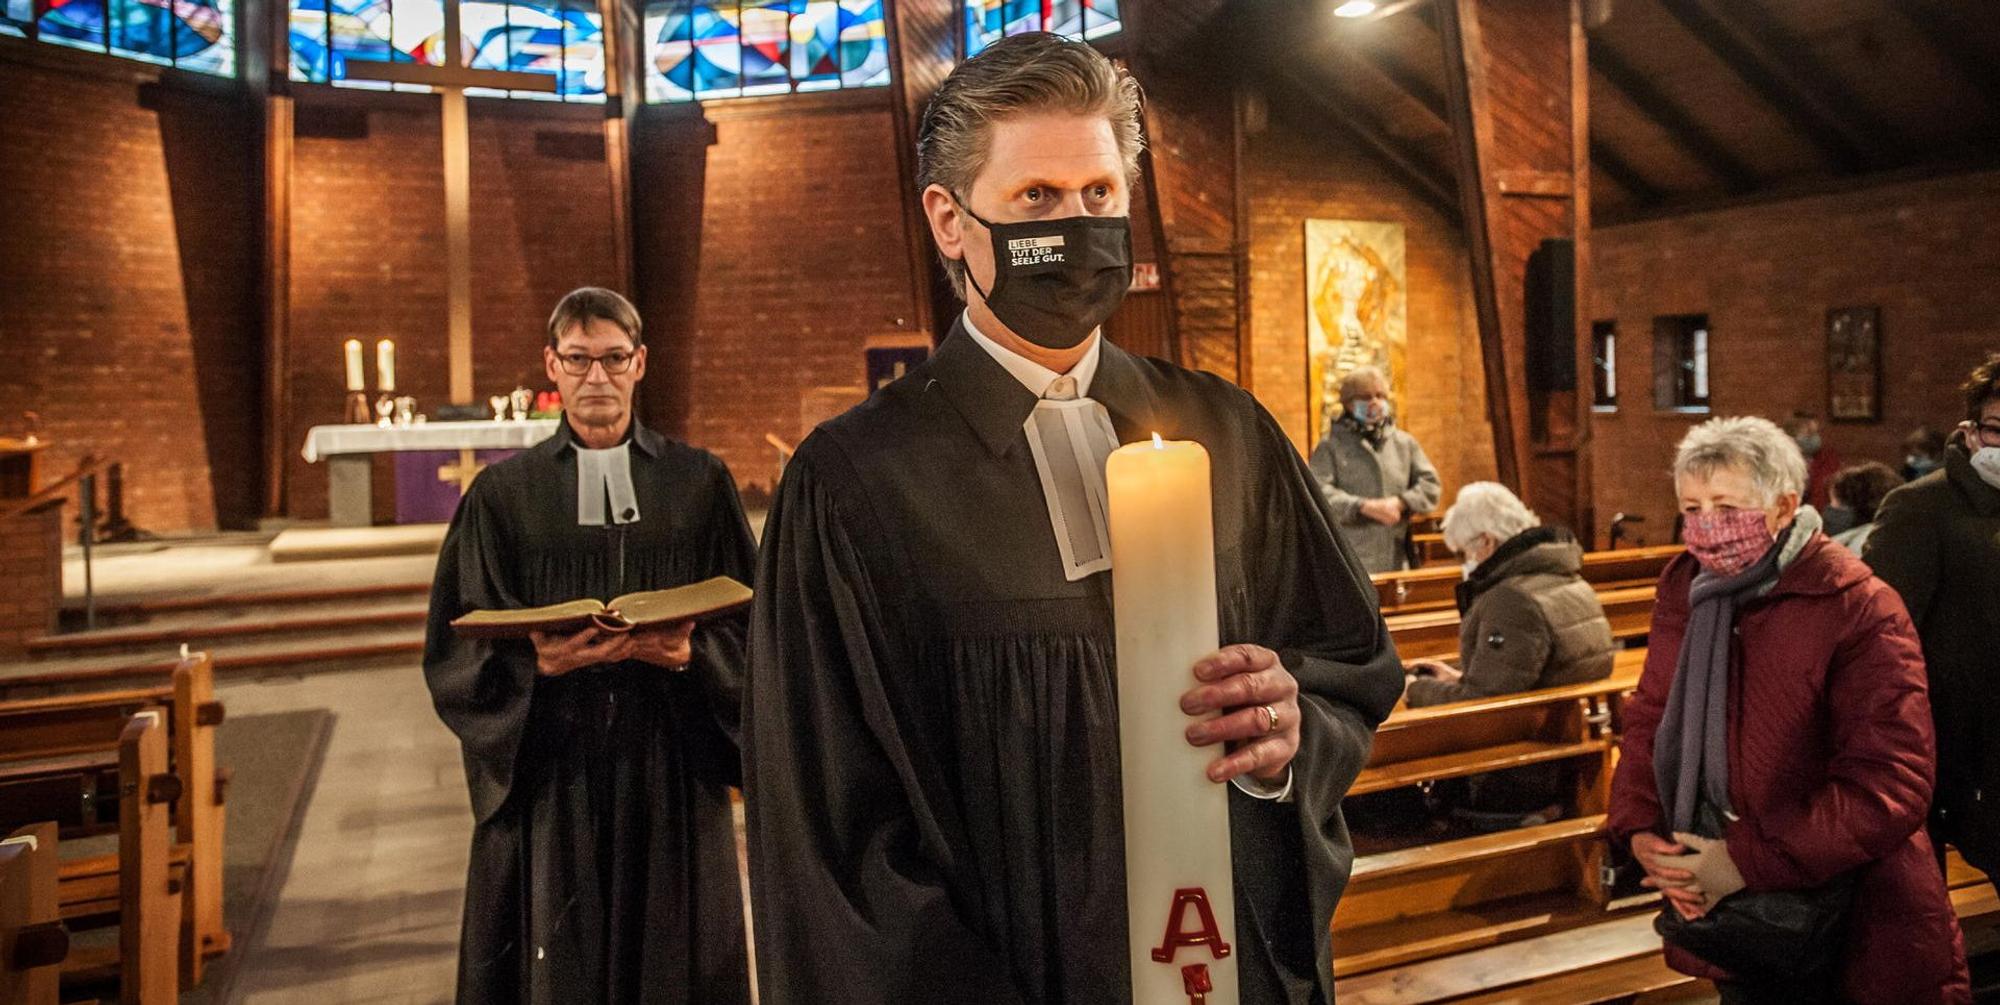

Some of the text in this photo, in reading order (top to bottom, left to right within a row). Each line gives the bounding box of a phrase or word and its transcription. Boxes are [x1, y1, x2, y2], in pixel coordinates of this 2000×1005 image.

[1010, 239, 1037, 249] LIEBE
[1011, 247, 1052, 258] TUT DER
[1011, 253, 1065, 266] SEELE GUT.
[1152, 887, 1231, 963] A
